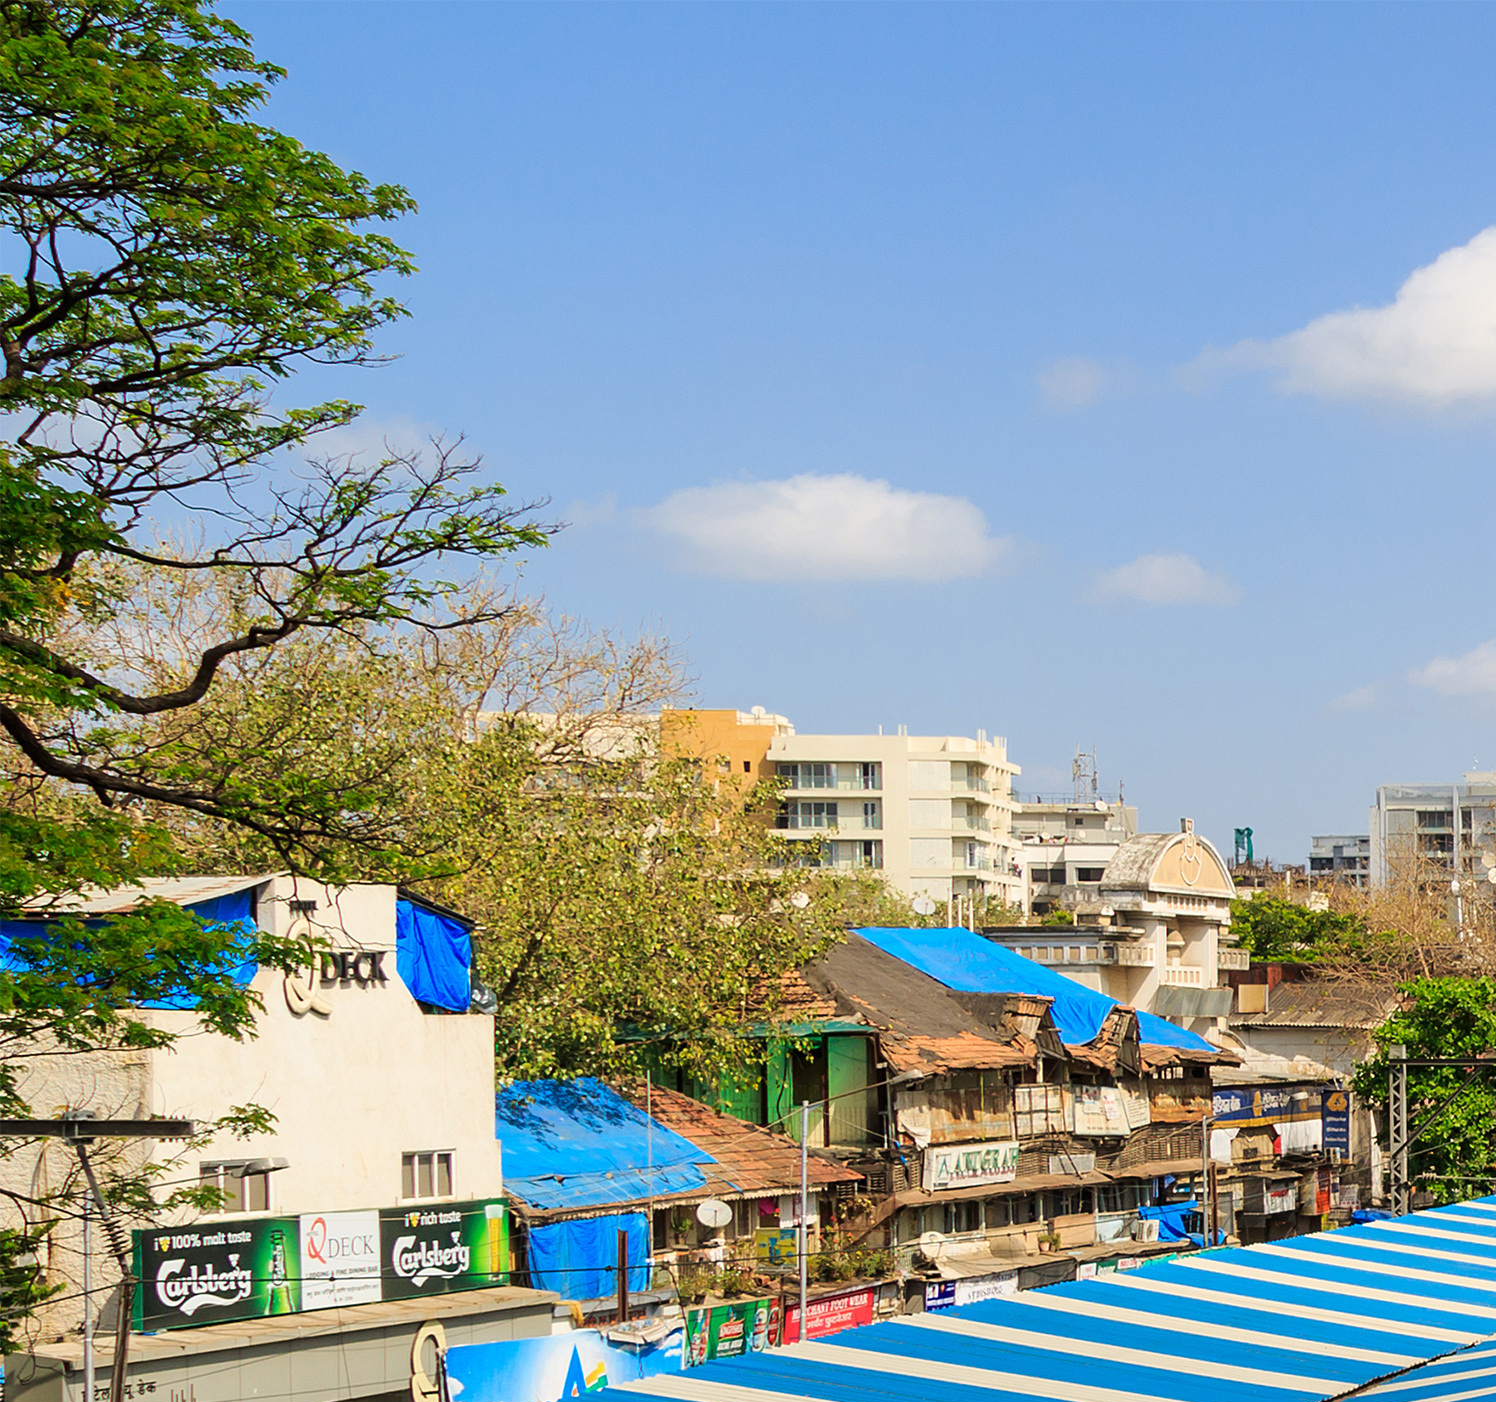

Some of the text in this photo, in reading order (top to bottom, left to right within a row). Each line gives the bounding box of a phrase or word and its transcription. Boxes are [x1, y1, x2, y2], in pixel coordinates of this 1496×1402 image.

[320, 950, 390, 982] DECK
[421, 1212, 438, 1225] rich
[439, 1211, 462, 1224] taste
[172, 1233, 201, 1249] 100%
[203, 1232, 226, 1246] malt
[227, 1231, 252, 1244] taste
[328, 1235, 374, 1258] DECK
[392, 1231, 470, 1287] Carlsberg
[156, 1254, 252, 1316] Carlsberg
[830, 1297, 849, 1311] FOOT
[849, 1293, 869, 1307] WEAR
